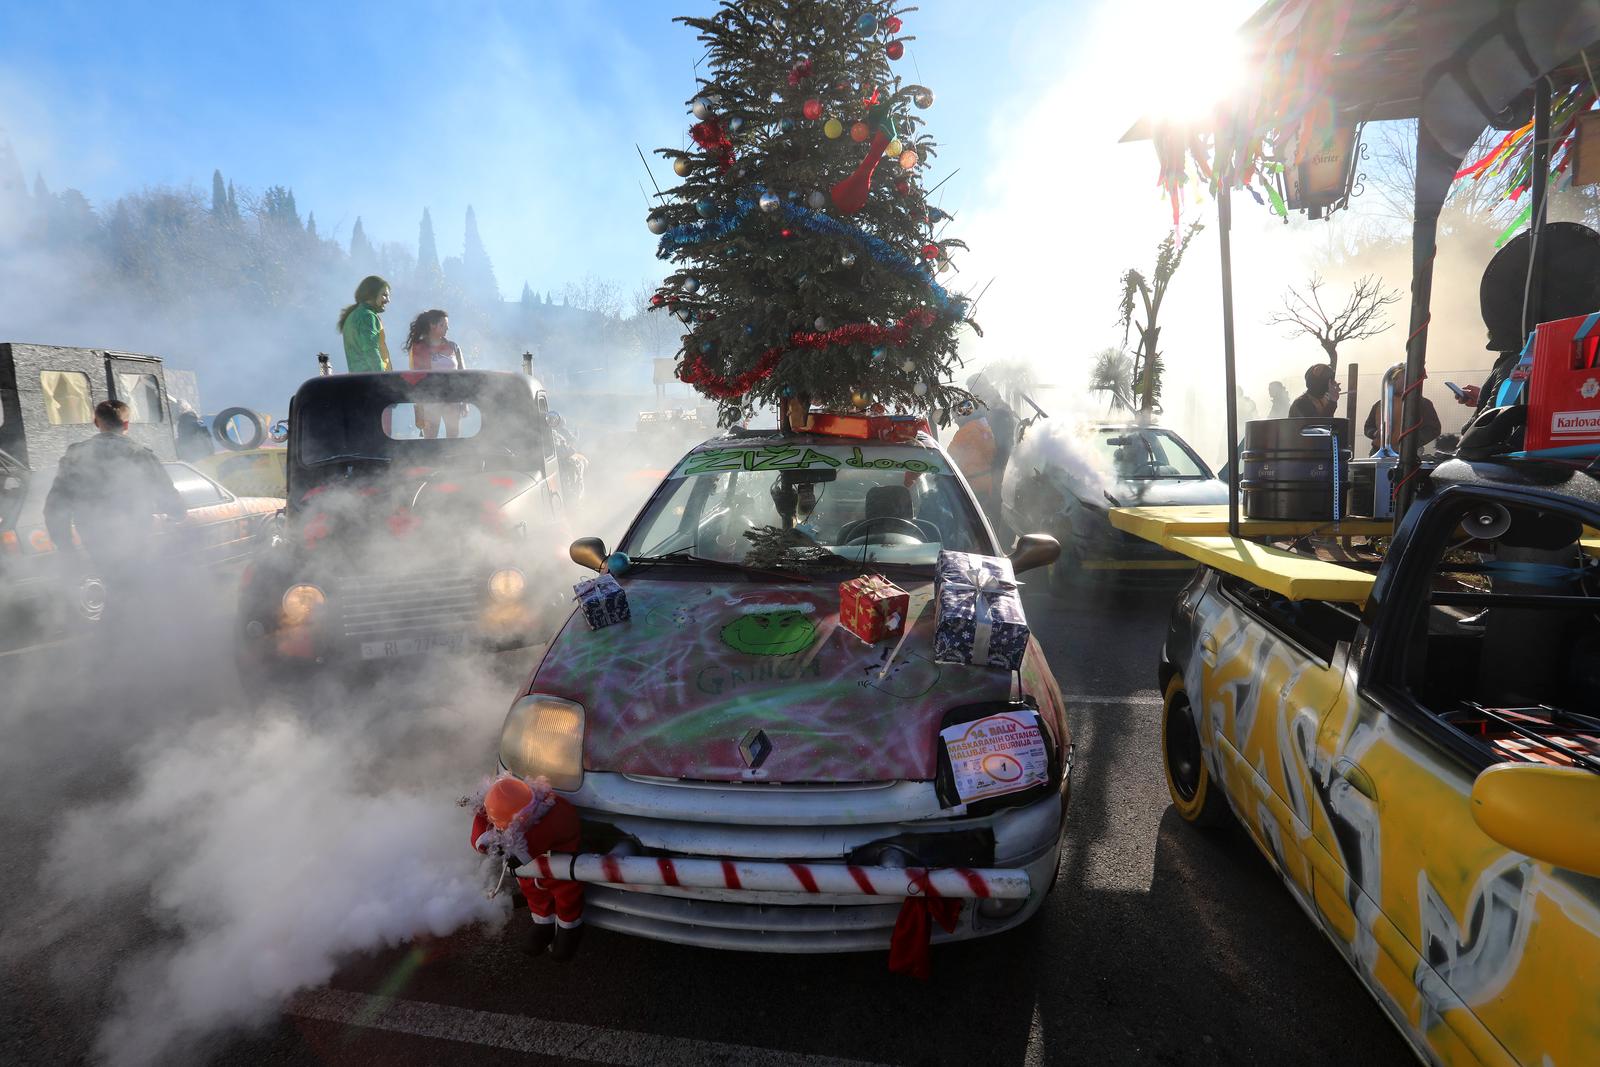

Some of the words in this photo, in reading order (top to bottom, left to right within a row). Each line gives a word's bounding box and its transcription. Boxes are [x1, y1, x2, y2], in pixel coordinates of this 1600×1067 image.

[684, 442, 842, 475] ŽIŽA
[846, 447, 940, 473] d.o.o.
[989, 723, 1017, 737] RALLY
[994, 739, 1031, 753] LIBURNIJA
[1001, 762, 1007, 772] 1
